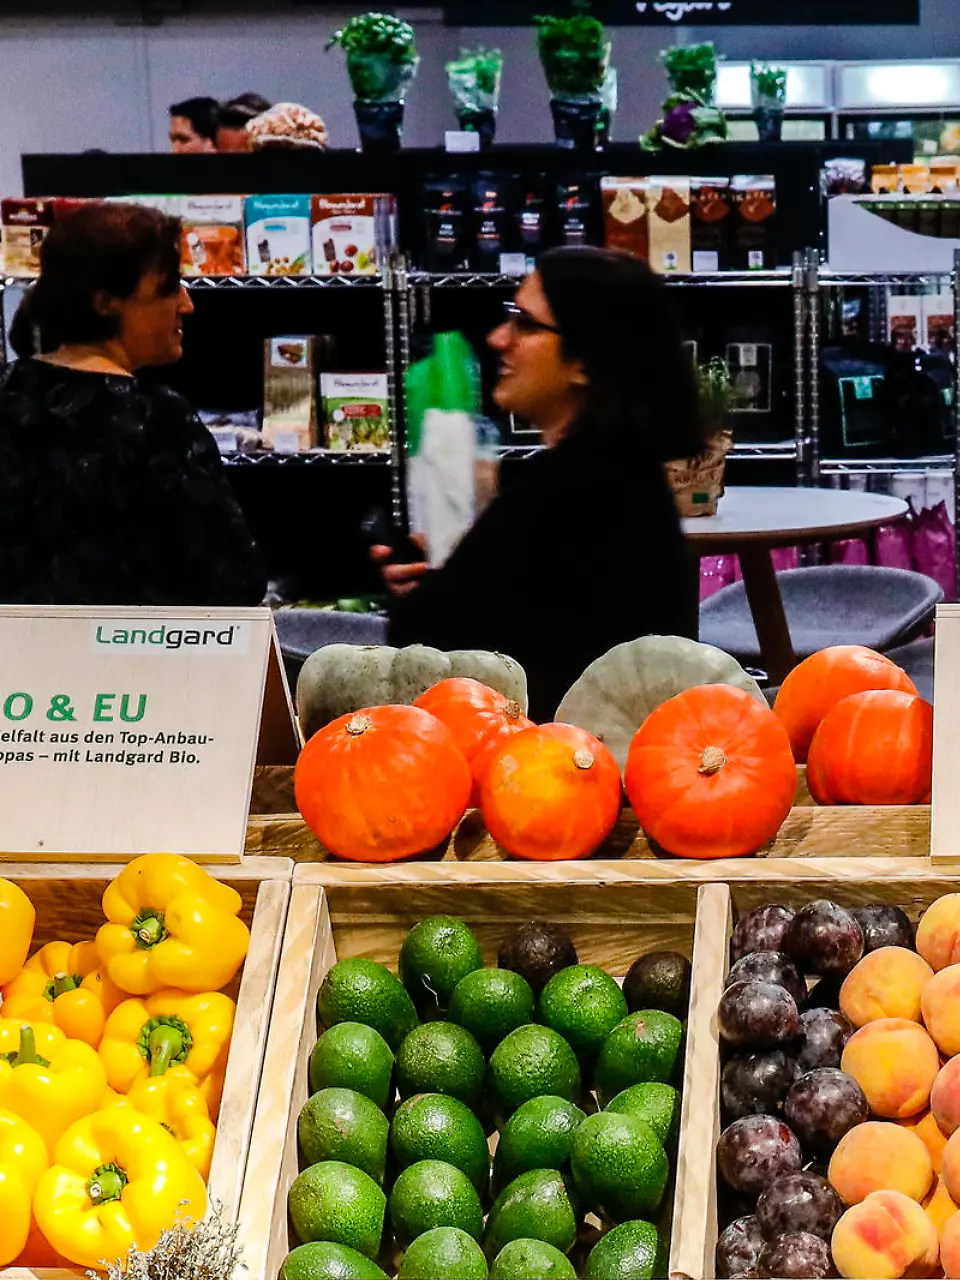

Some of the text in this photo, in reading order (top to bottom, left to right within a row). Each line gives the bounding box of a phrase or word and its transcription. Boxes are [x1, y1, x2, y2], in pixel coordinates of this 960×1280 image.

[96, 624, 235, 649] Landgard
[3, 691, 148, 722] O & EU
[0, 729, 215, 747] elfalt aus den Top-Anbau-
[53, 749, 80, 763] mit
[85, 750, 163, 766] Landgard
[169, 750, 201, 764] Bio.
